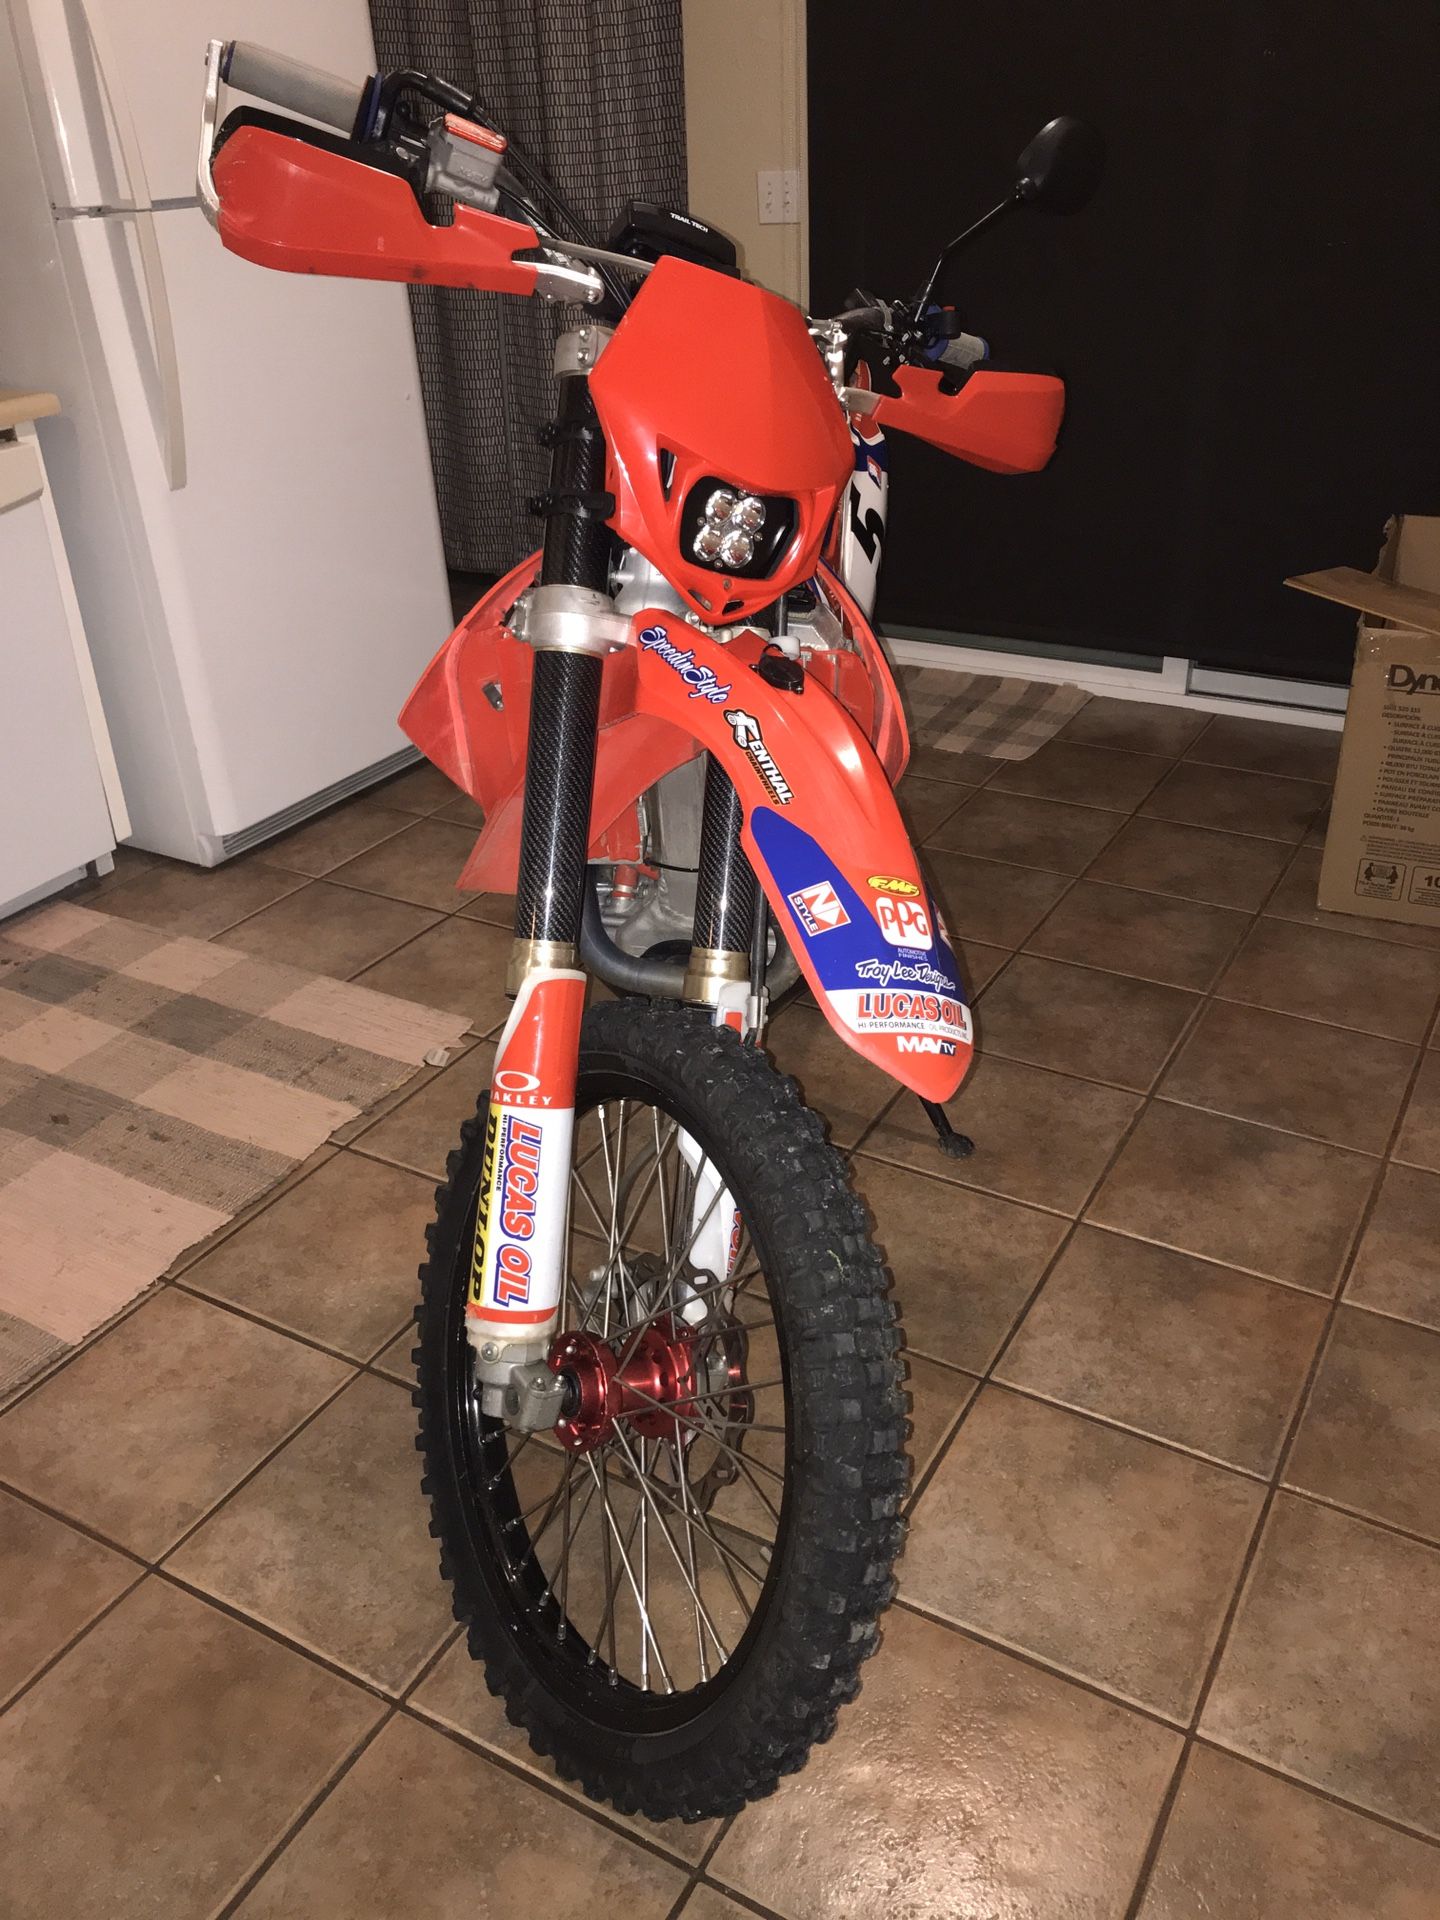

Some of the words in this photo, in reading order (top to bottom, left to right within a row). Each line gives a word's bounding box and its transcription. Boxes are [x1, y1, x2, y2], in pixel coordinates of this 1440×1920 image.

[670, 212, 691, 225] TRAIL
[691, 220, 709, 233] TECH
[724, 710, 793, 805] RENTHAL
[746, 752, 780, 805] CHAINWHEELS
[867, 877, 919, 895] FMF
[793, 896, 819, 932] STYLE
[880, 899, 929, 938] PPG
[855, 958, 891, 987] Troy
[893, 960, 916, 980] Lee
[857, 993, 941, 1022] LUCAS
[940, 999, 967, 1030] OIL
[869, 1021, 925, 1030] PERFORMANCE
[499, 1114, 543, 1242] LUCAS
[472, 1112, 498, 1301] DUNLOP
[493, 1243, 532, 1307] OIL
